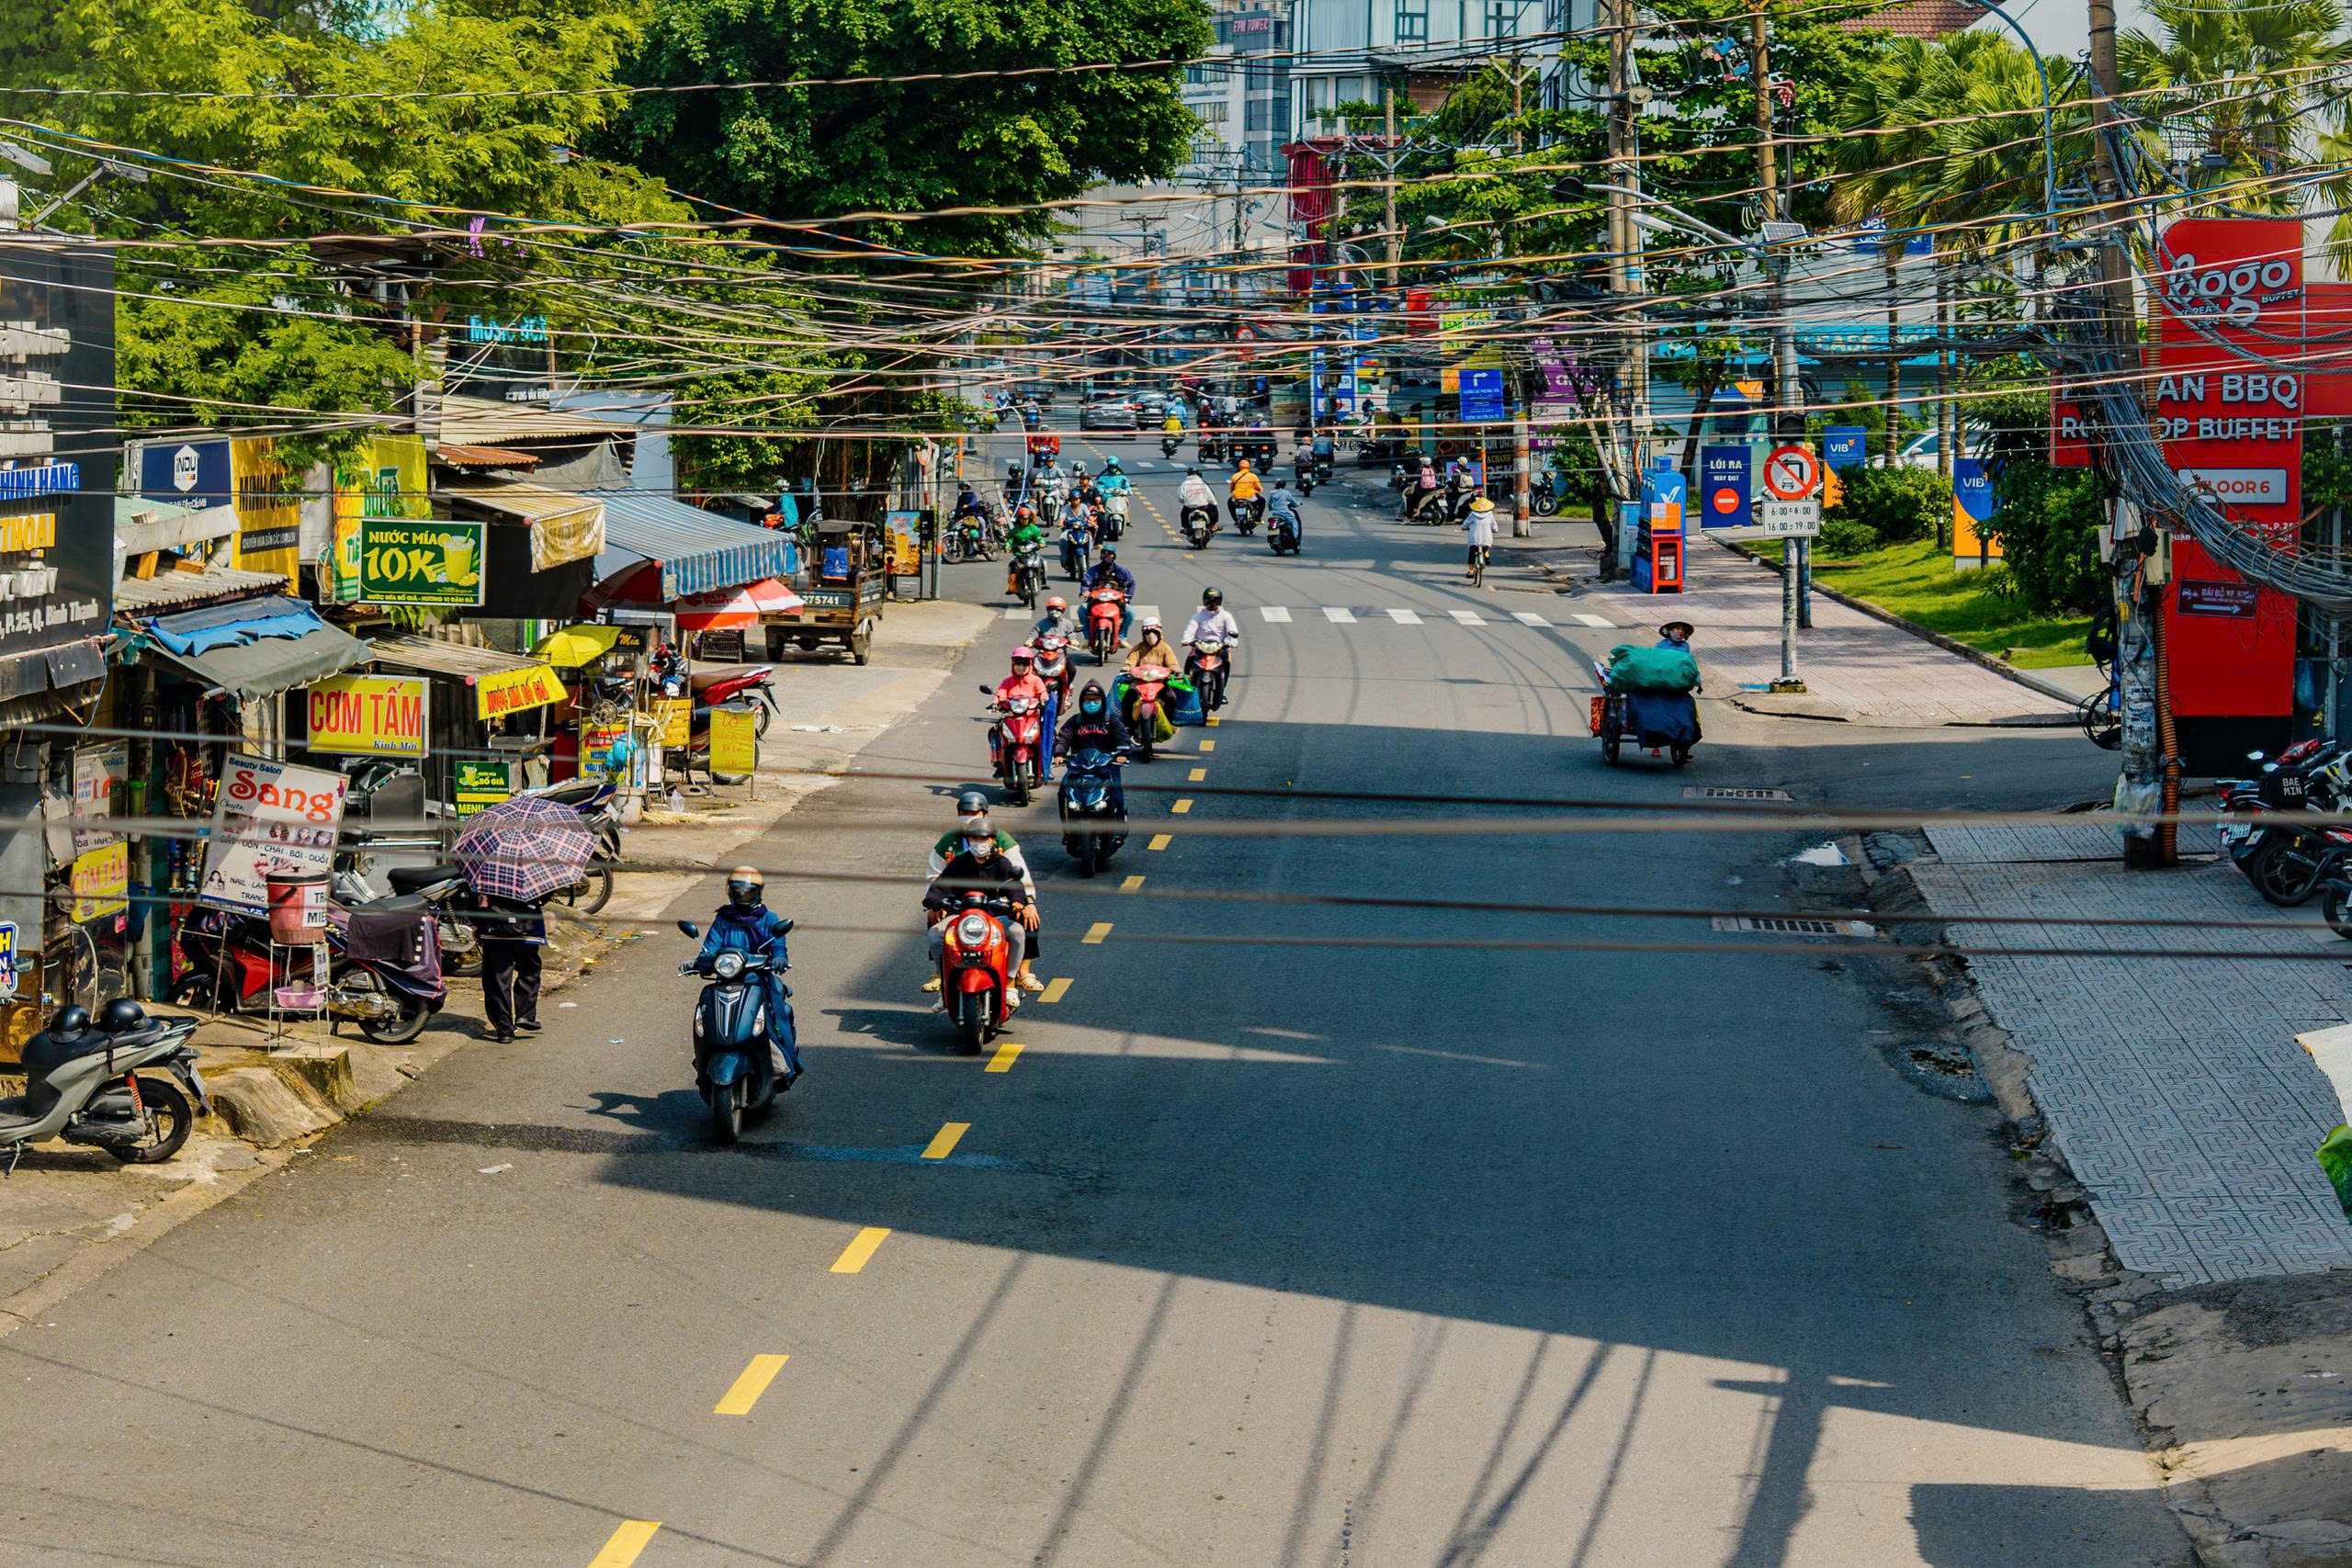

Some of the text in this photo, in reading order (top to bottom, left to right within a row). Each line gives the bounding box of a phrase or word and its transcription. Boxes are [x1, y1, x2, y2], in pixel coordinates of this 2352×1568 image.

[2167, 252, 2291, 326] Bogo
[2222, 374, 2299, 410] BBQ
[2199, 416, 2299, 441] BUFFET
[1829, 443, 1849, 453] VIB
[1710, 457, 1743, 469] LỐI RA
[0, 459, 37, 501] HÍNH
[1962, 477, 1985, 488] VIB
[2259, 480, 2271, 494] 6
[1768, 521, 1815, 532] 16:00 19:00
[368, 528, 438, 545] NƯỚC MÍA
[363, 546, 437, 583] 10K
[69, 597, 99, 626] Thạnh
[310, 682, 423, 738] CƠM TẤM
[229, 756, 283, 776] Beauty Salon
[2282, 777, 2301, 786] BAE
[227, 769, 334, 823] Sang
[2283, 786, 2302, 796] MIN
[458, 803, 485, 815] MENU
[229, 876, 247, 887] NAIL
